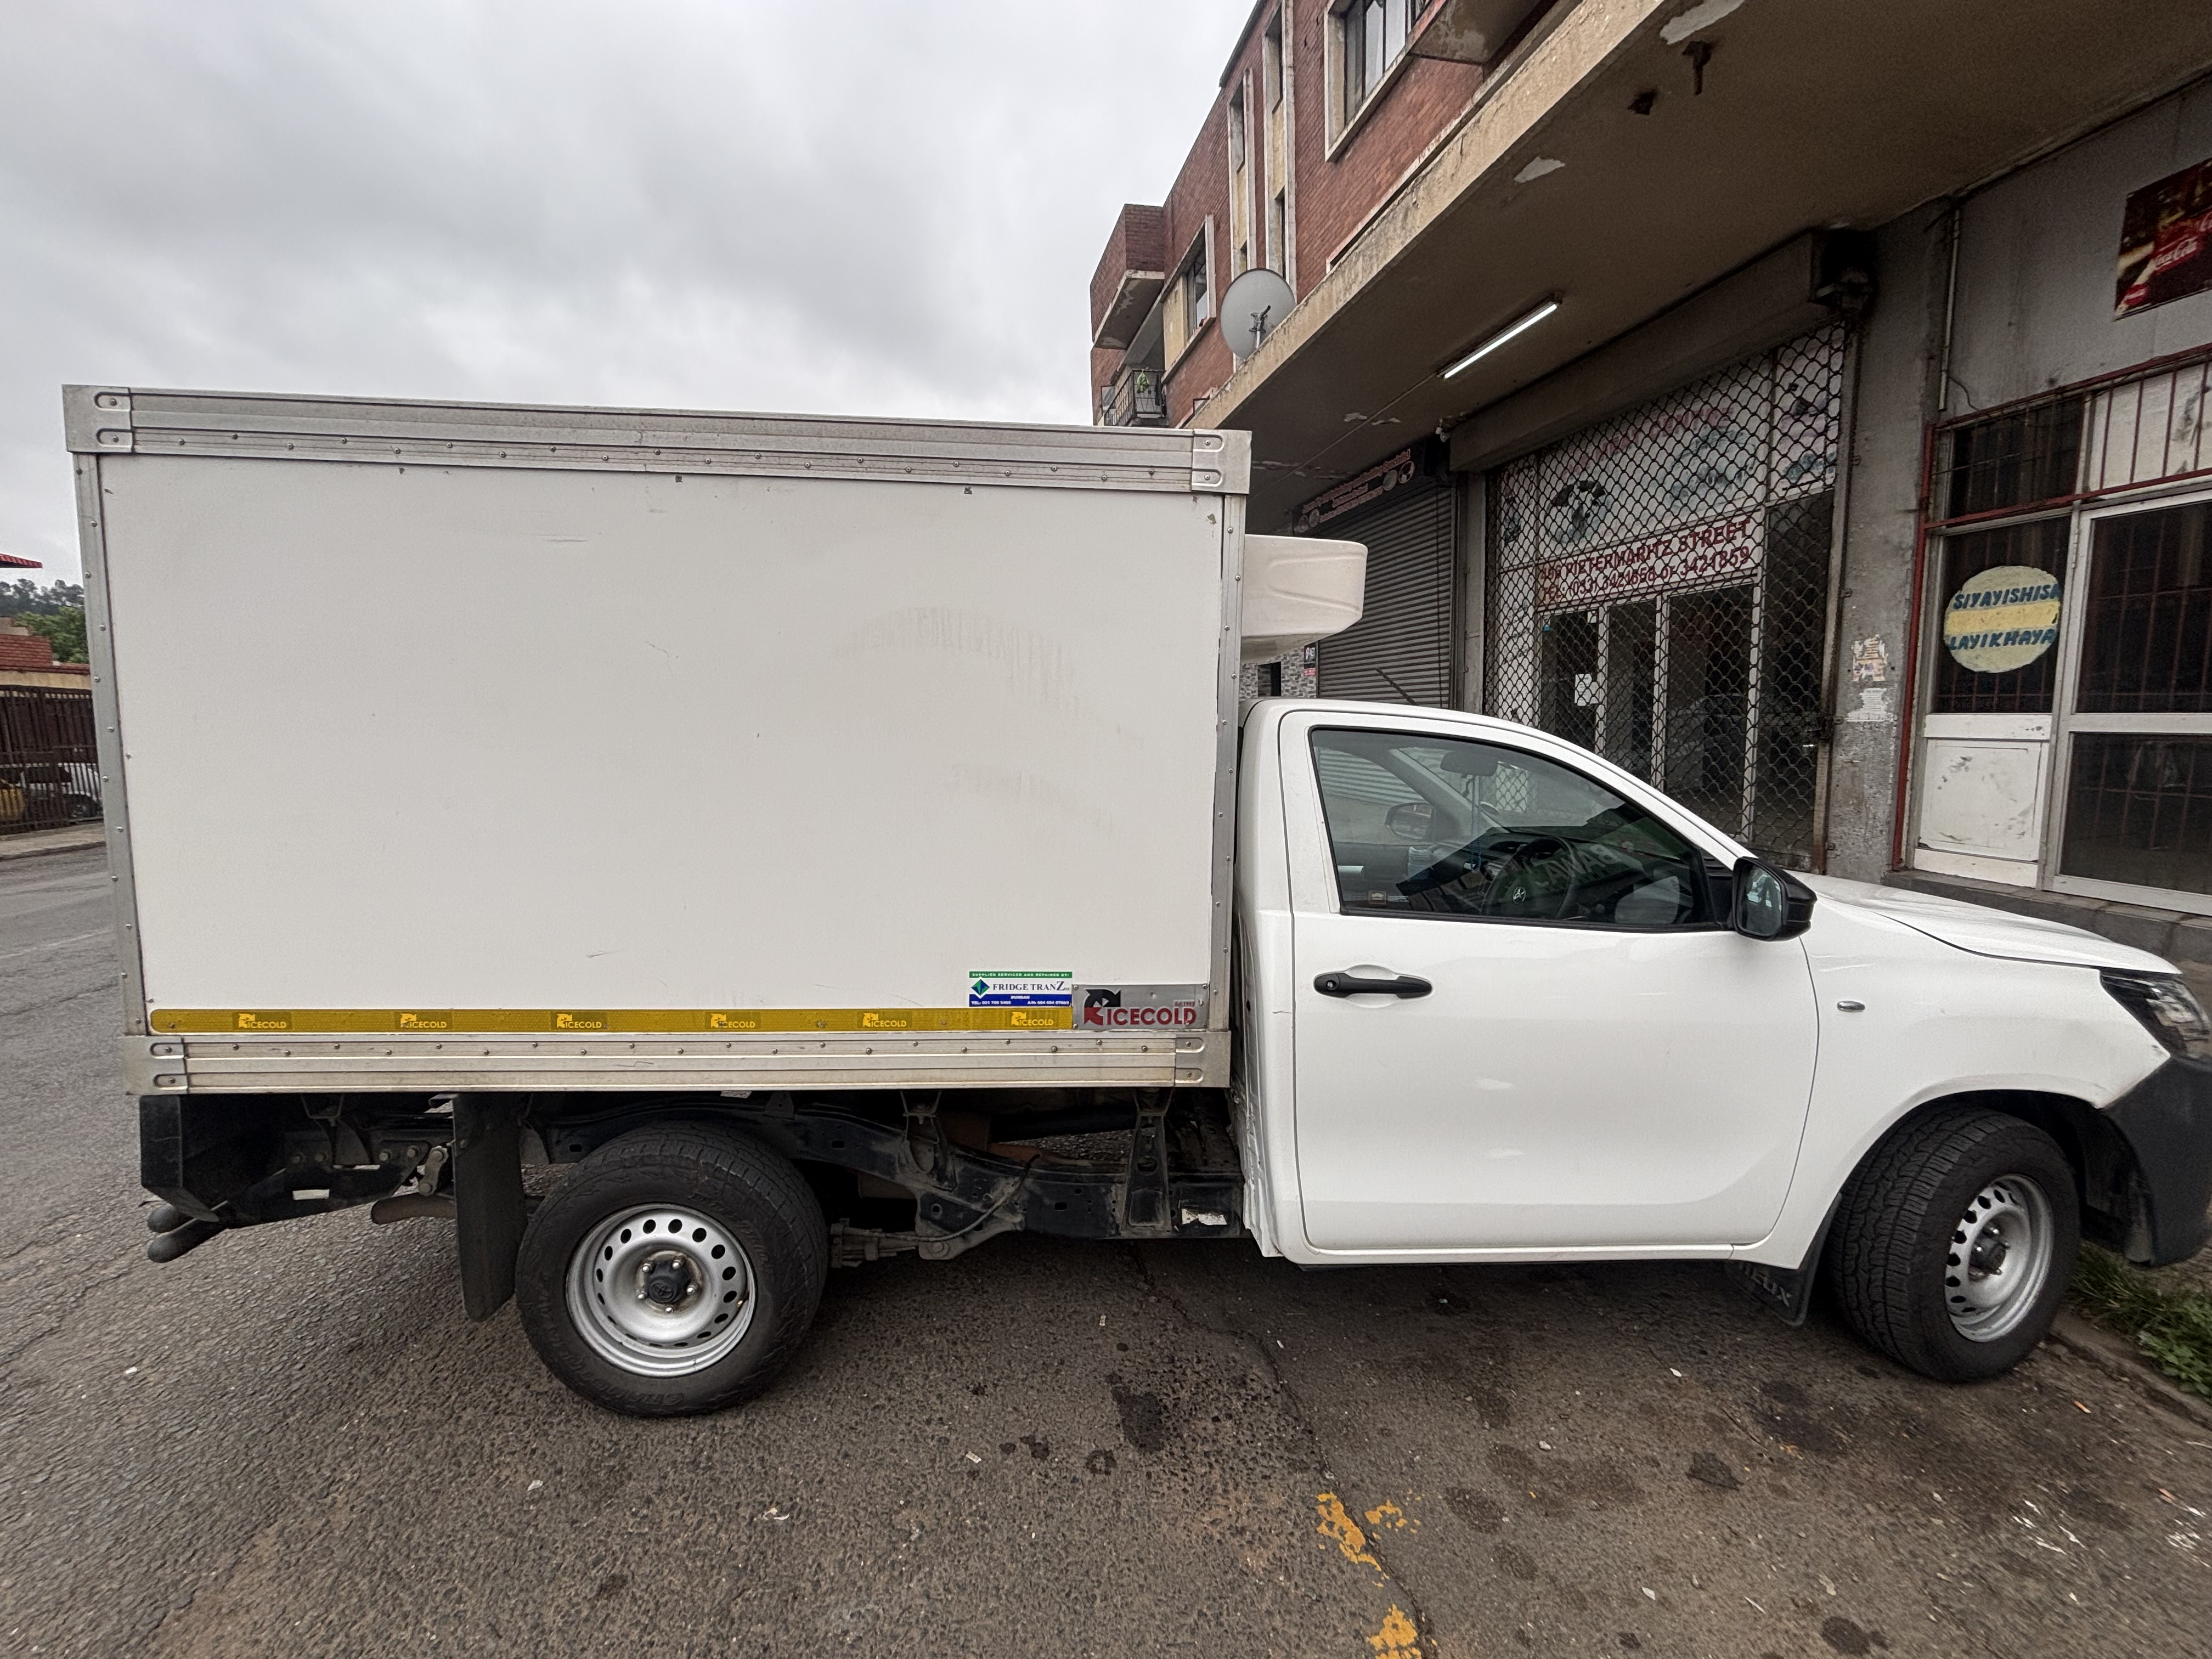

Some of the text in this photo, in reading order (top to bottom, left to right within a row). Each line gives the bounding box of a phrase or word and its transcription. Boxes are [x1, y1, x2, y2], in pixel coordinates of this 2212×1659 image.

[1679, 518, 1750, 552] STREET
[1679, 546, 1749, 575] 3421859
[1948, 629, 2056, 651] LAYIKHAYA
[247, 1021, 287, 1029] ICECOLD
[409, 1021, 447, 1029] ICECOLD
[871, 1019, 907, 1028] ICECOLD
[1107, 1007, 1197, 1025] ICECOLD
